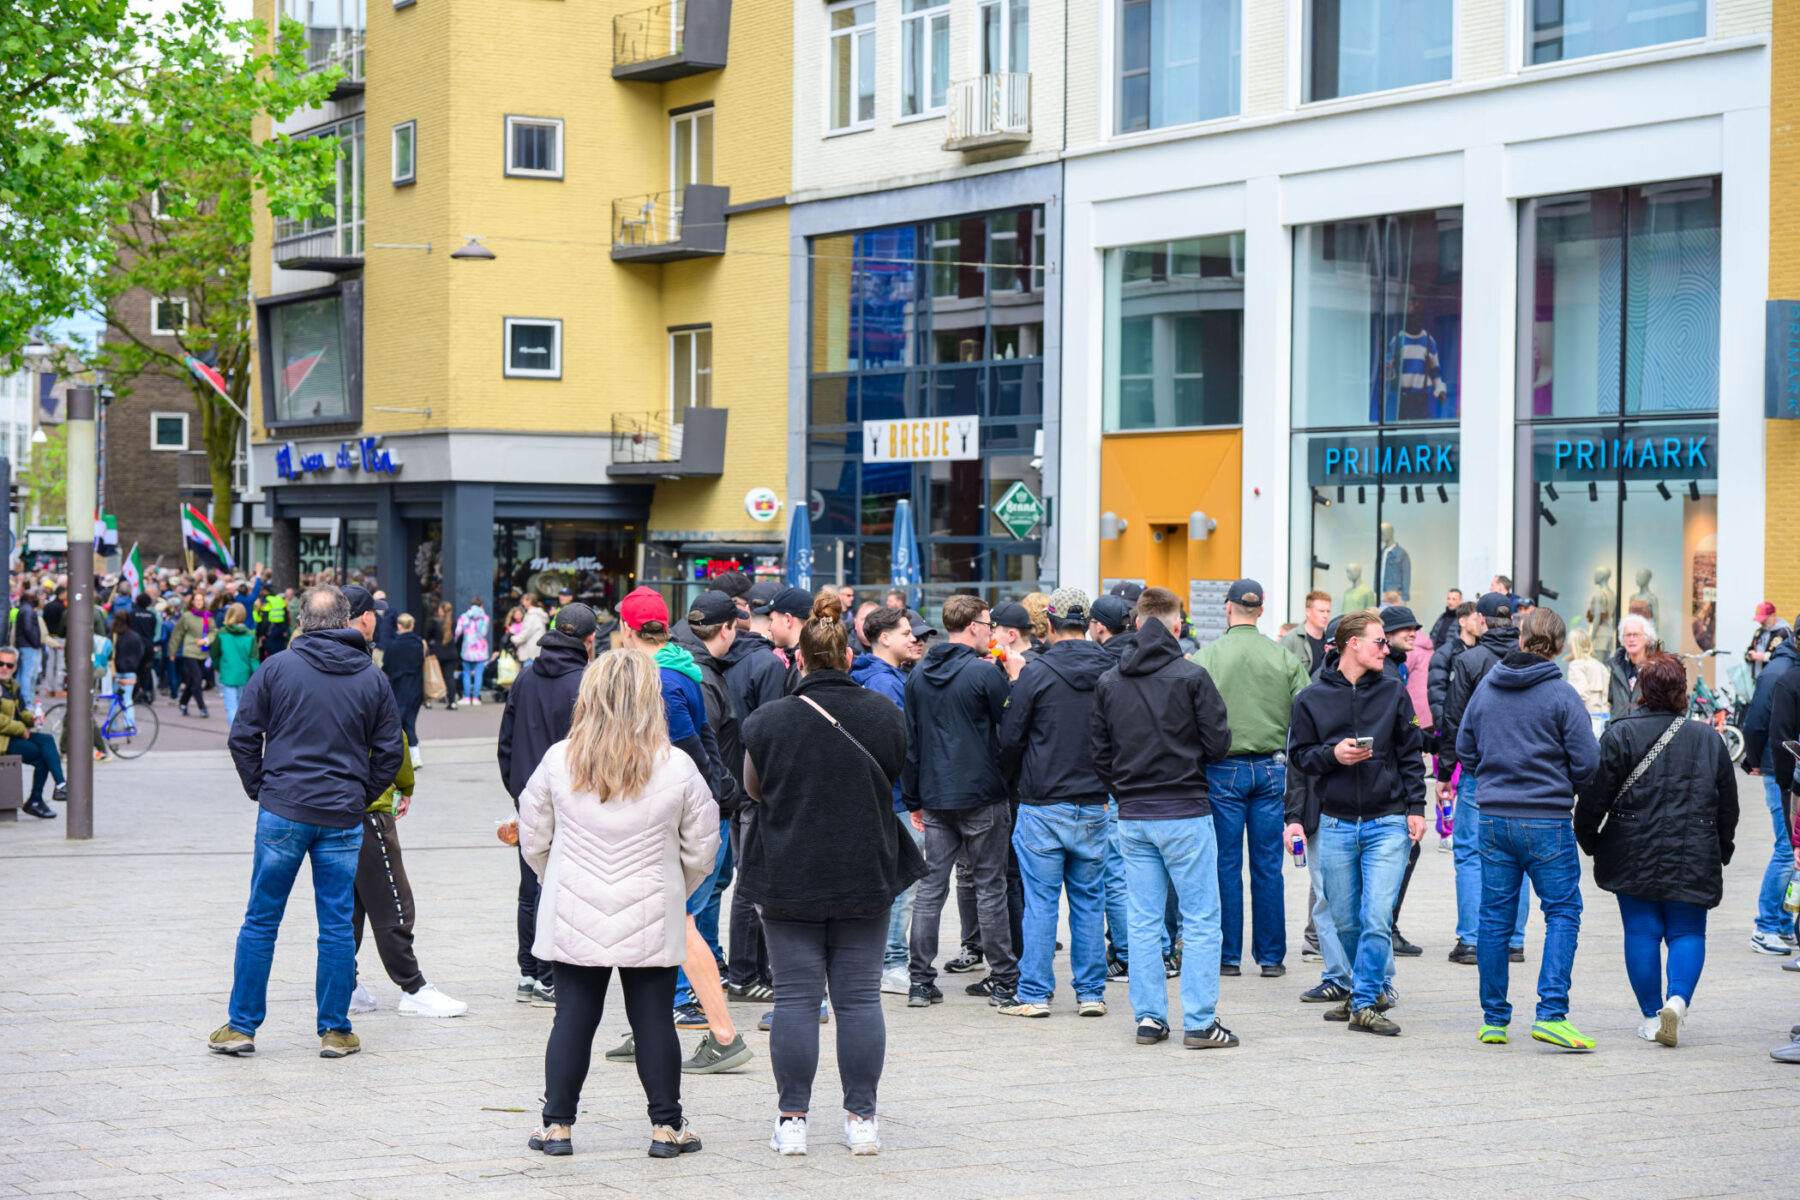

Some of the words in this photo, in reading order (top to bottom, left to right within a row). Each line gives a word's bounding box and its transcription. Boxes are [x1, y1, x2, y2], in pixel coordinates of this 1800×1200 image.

[889, 421, 950, 459] BREGJE
[1555, 436, 1708, 470] PRIMARK
[1325, 444, 1453, 475] PRIMARK
